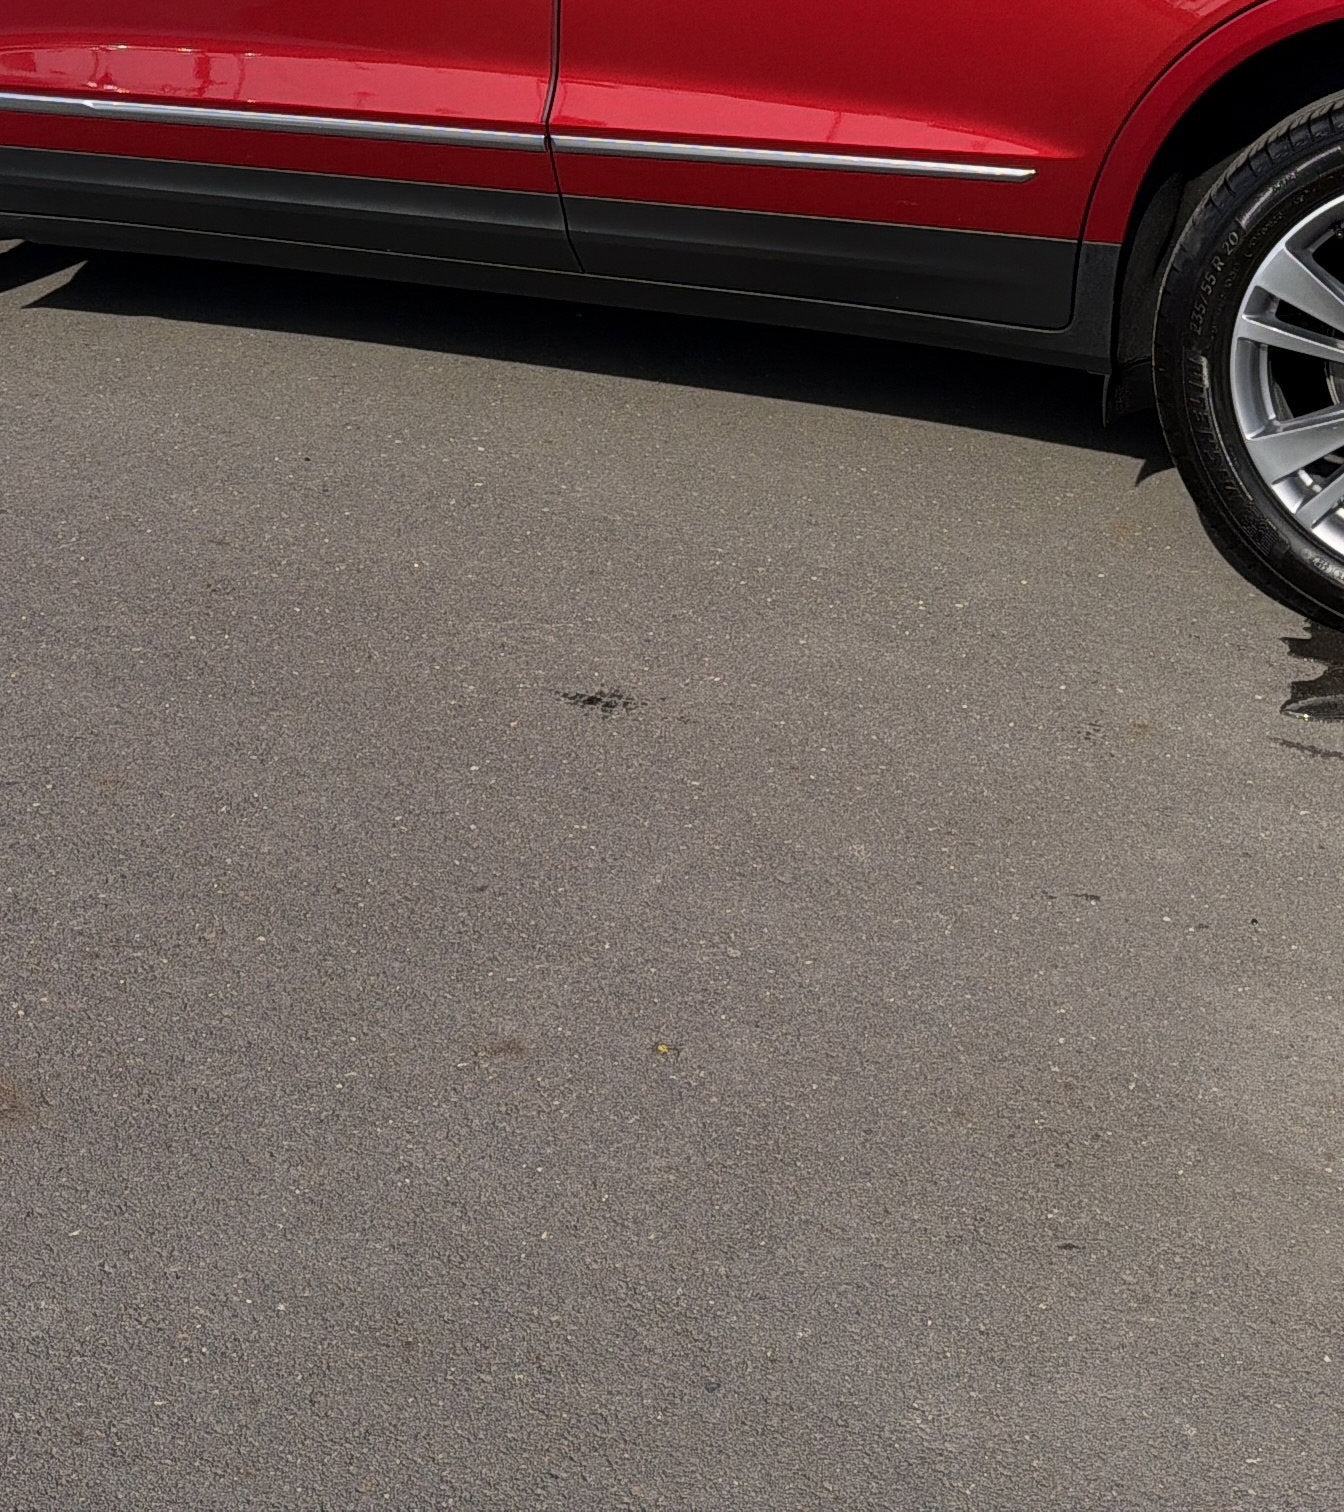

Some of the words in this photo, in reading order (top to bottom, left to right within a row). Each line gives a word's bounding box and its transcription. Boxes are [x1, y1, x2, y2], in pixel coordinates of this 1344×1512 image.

[1190, 271, 1217, 336] 235/55
[1211, 255, 1225, 272] R
[1222, 231, 1239, 257] 20
